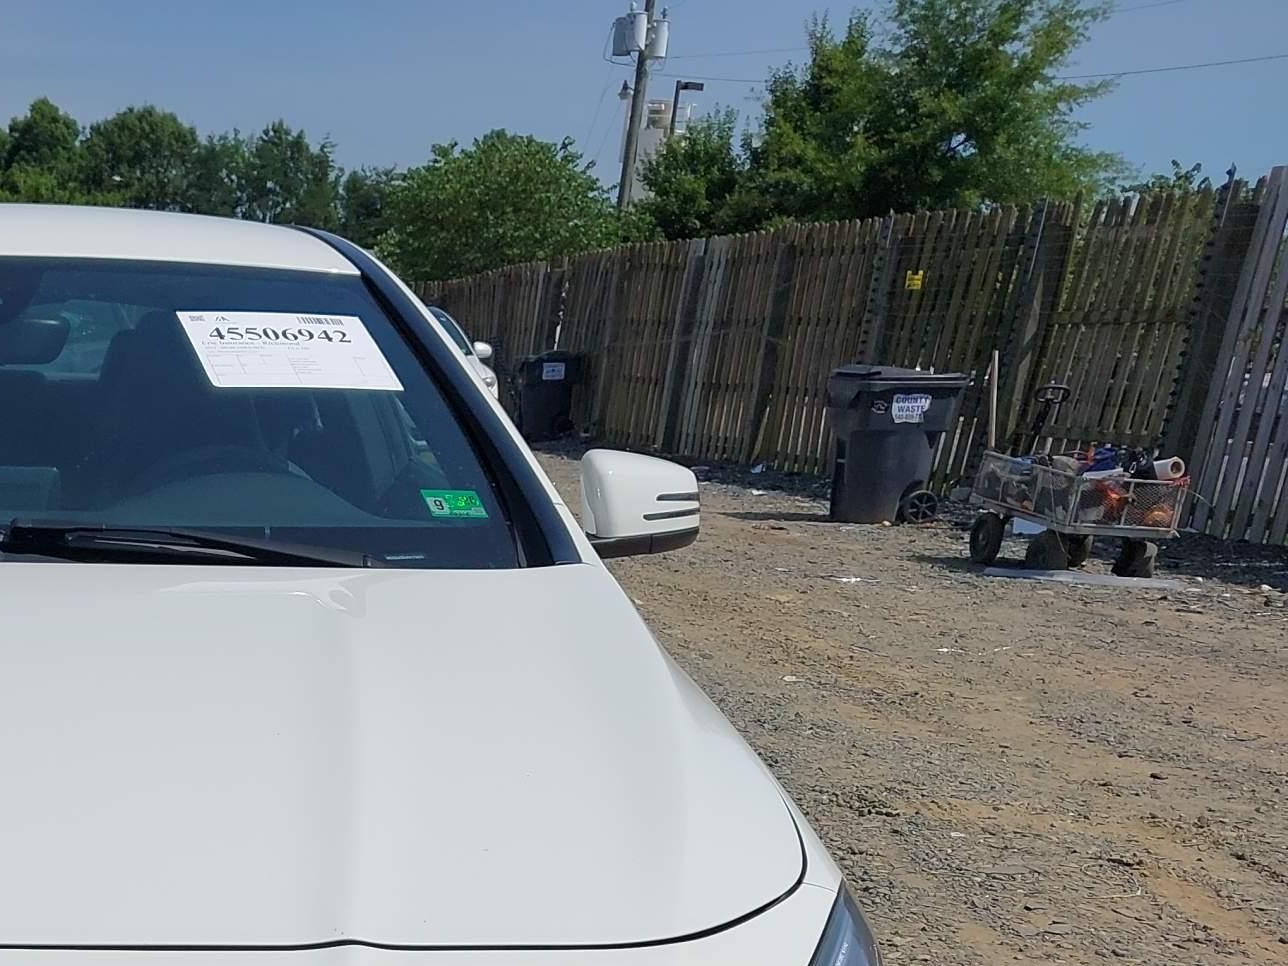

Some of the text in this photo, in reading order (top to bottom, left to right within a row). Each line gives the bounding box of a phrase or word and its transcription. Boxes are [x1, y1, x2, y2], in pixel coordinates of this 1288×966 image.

[208, 327, 352, 344] 45506942
[896, 396, 930, 404] COUNTY
[433, 499, 445, 511] 9
